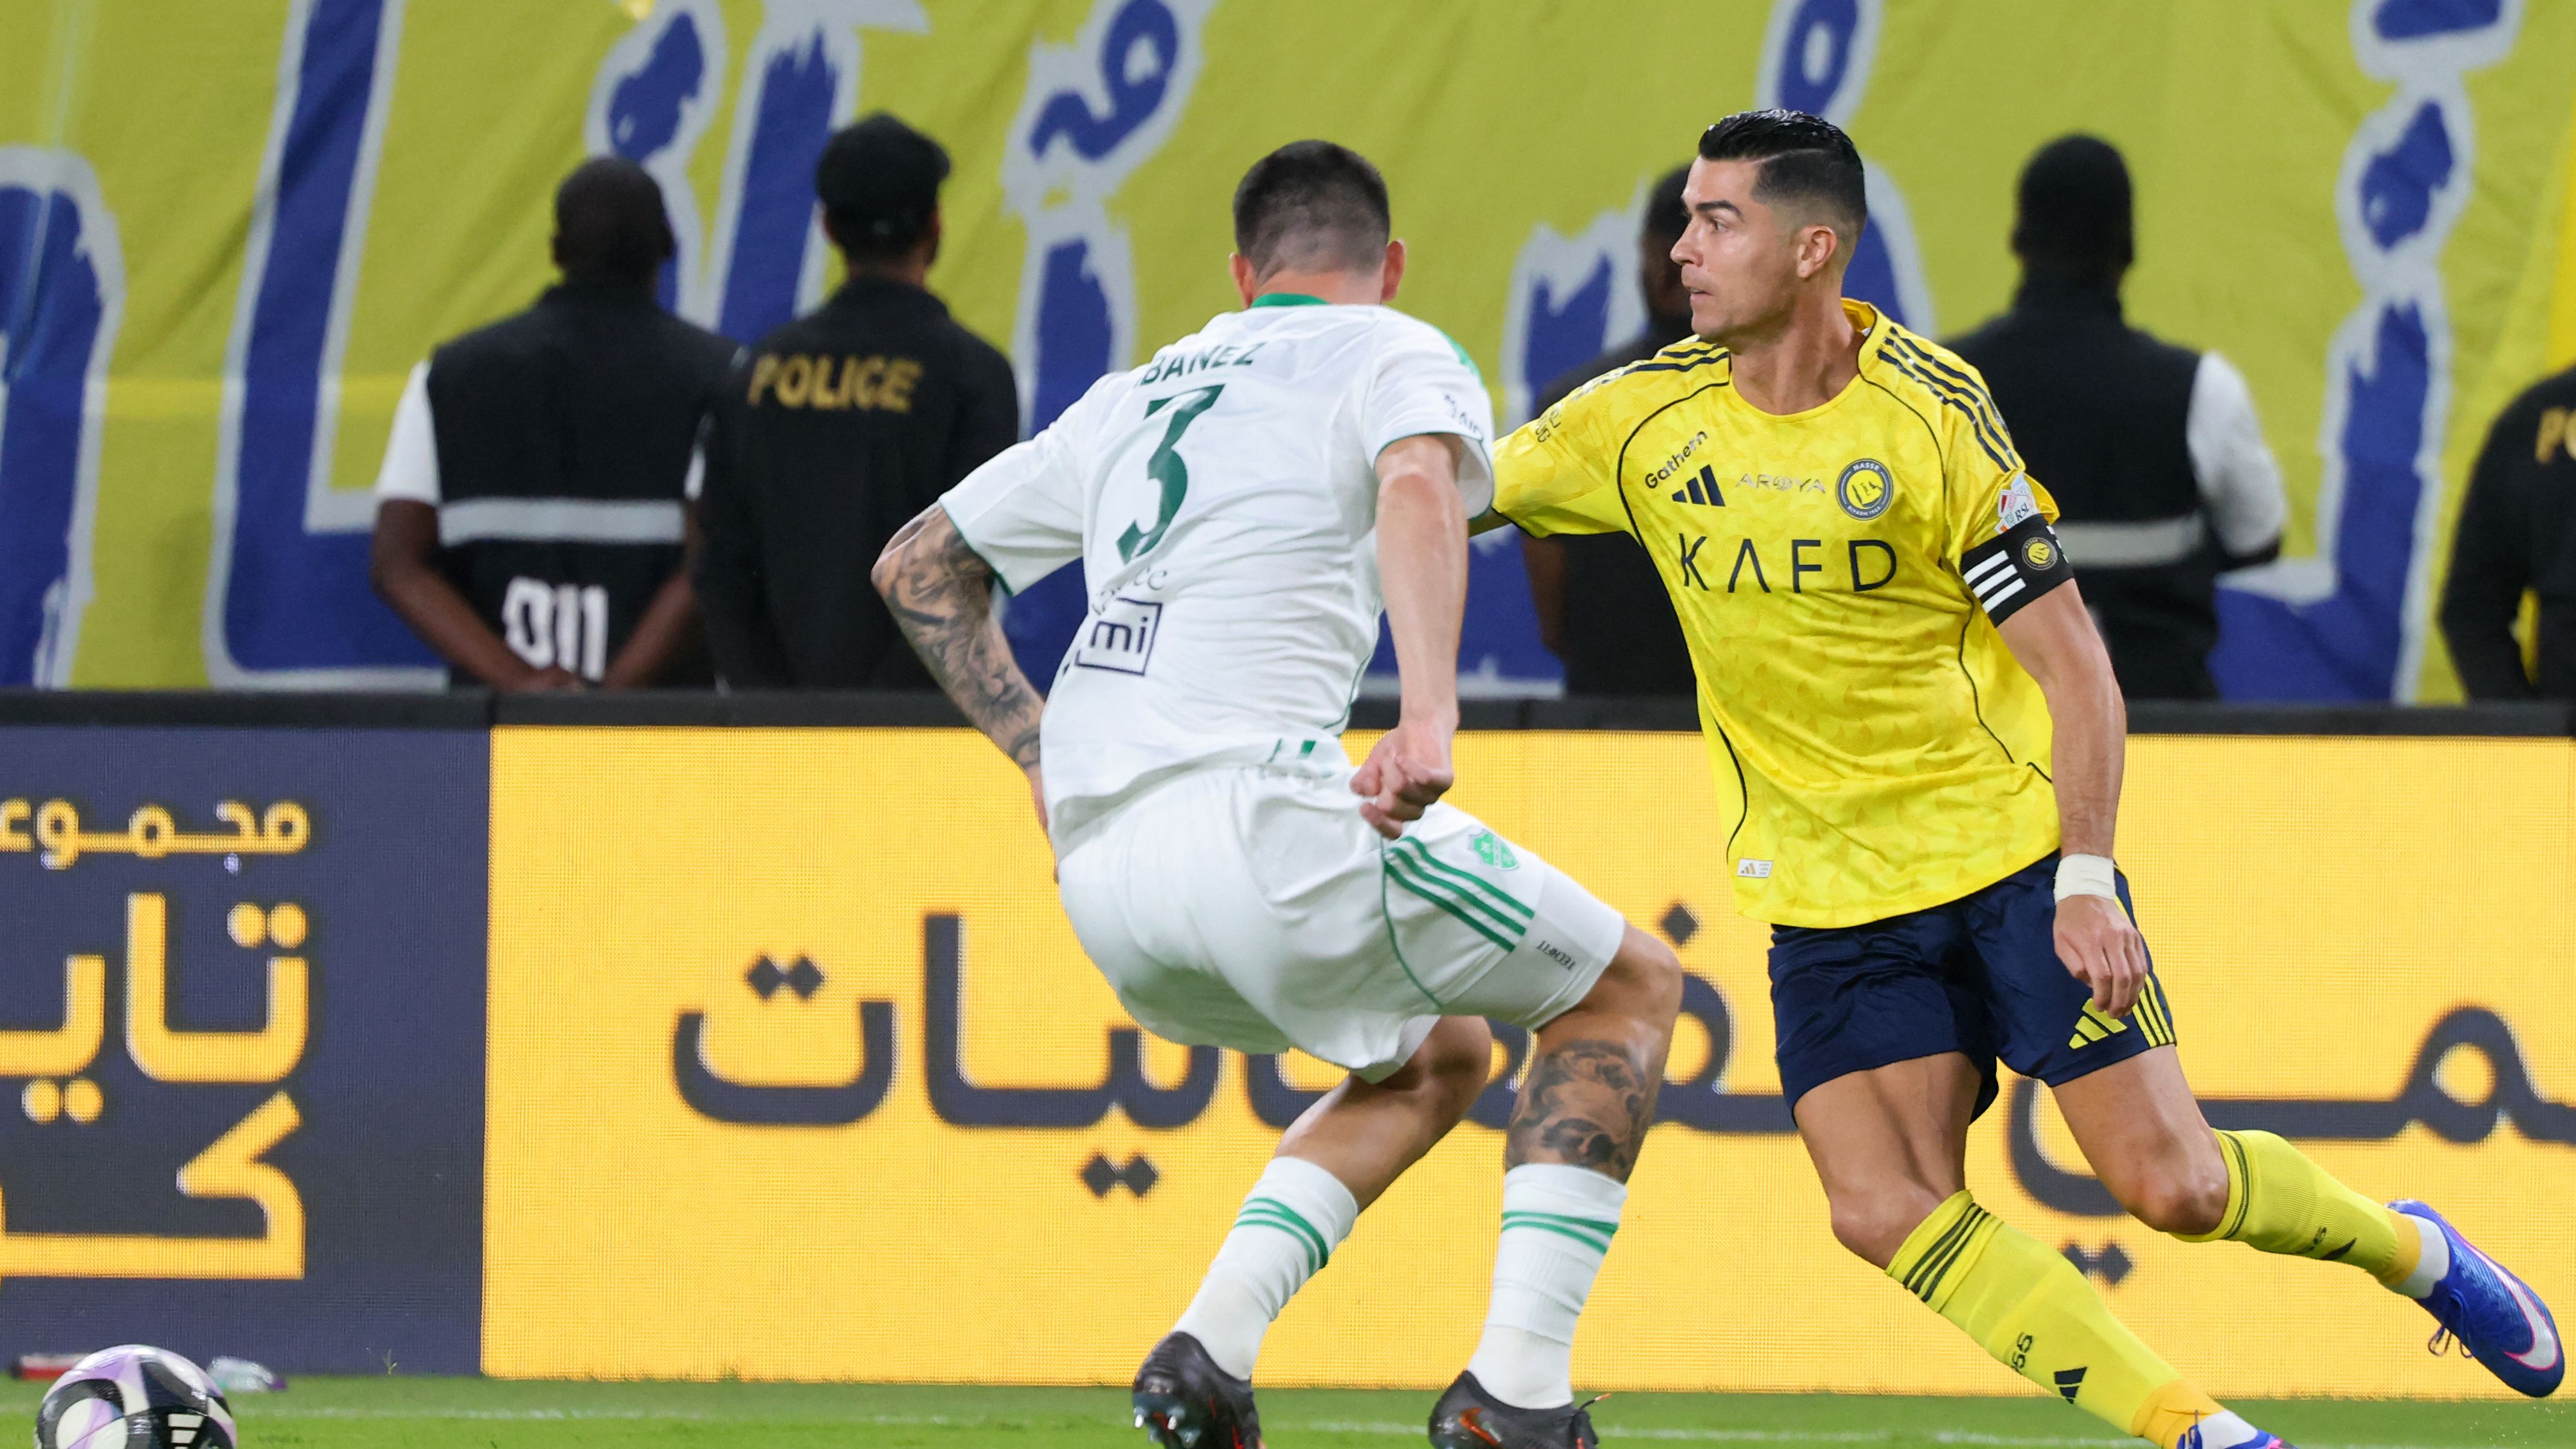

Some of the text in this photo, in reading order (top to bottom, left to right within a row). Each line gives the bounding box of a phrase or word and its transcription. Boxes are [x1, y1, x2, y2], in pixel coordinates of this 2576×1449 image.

[749, 354, 923, 412] POLICE
[1117, 384, 1225, 564] 3
[1644, 430, 1708, 489] Gathern
[1853, 462, 1879, 471] NASSR
[1089, 615, 1149, 655] mi
